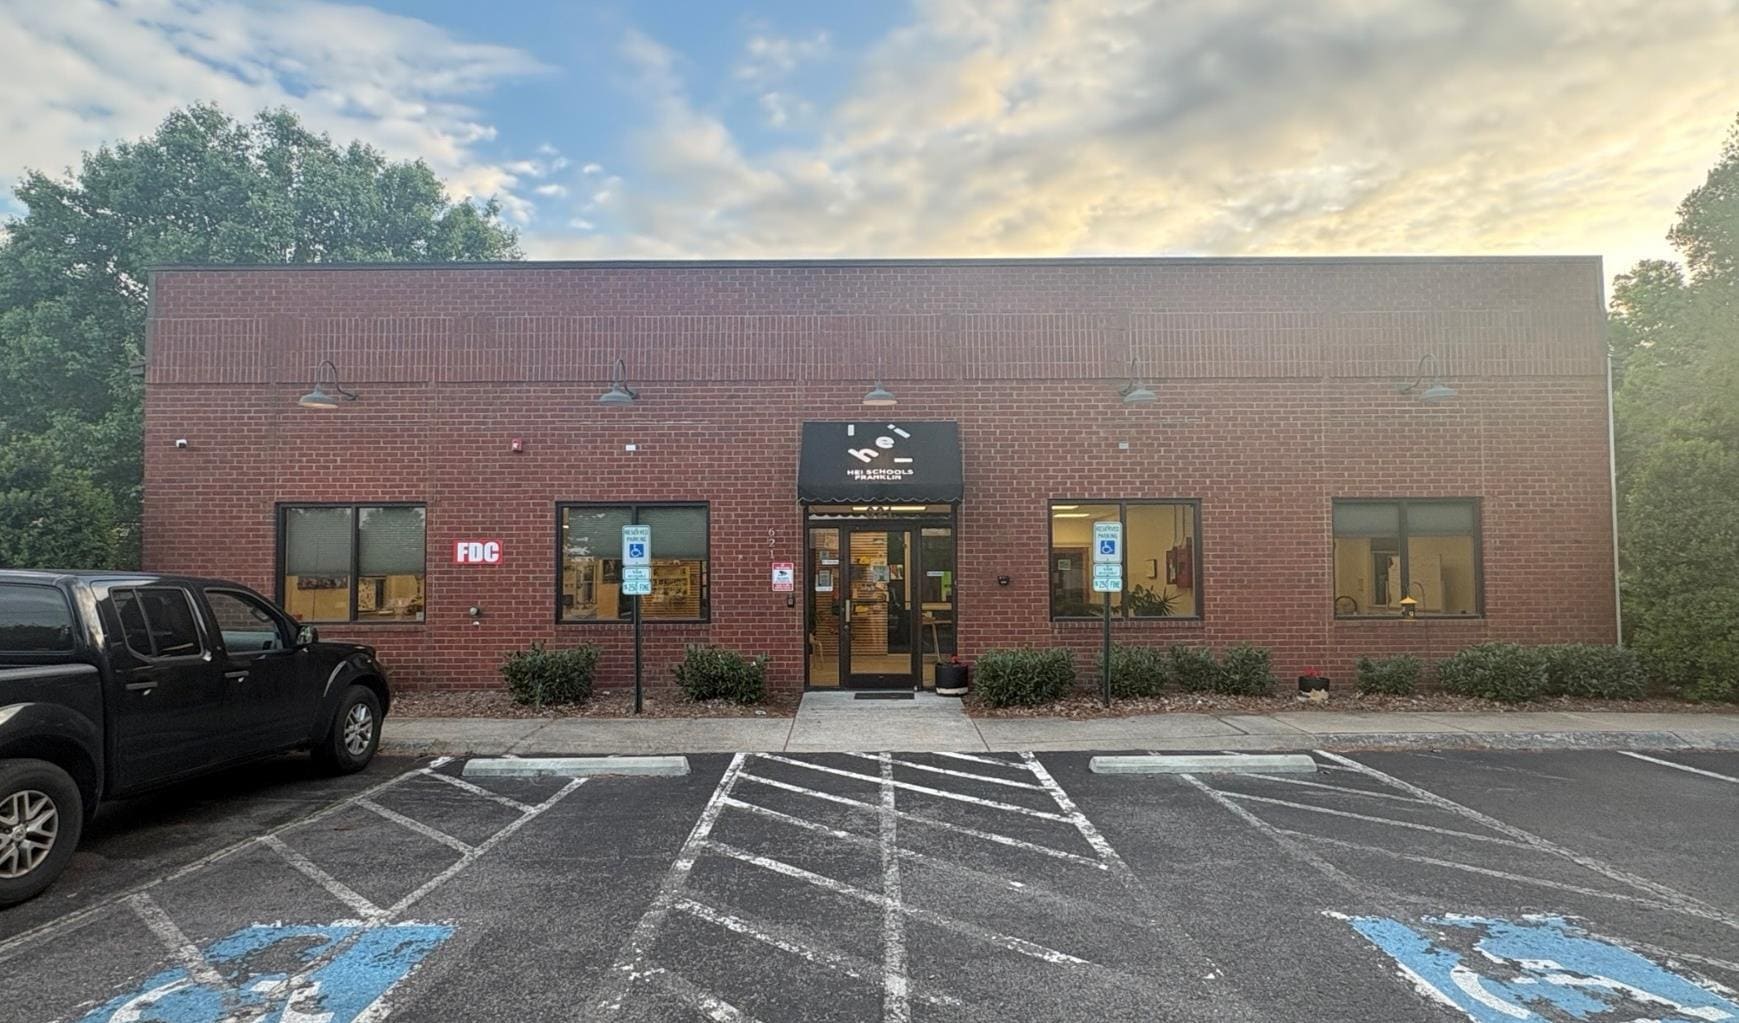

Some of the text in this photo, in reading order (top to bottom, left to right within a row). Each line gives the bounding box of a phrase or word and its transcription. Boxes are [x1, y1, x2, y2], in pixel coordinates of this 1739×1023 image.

[457, 541, 500, 563] FDC
[768, 528, 776, 559] 621
[639, 583, 649, 592] FINE
